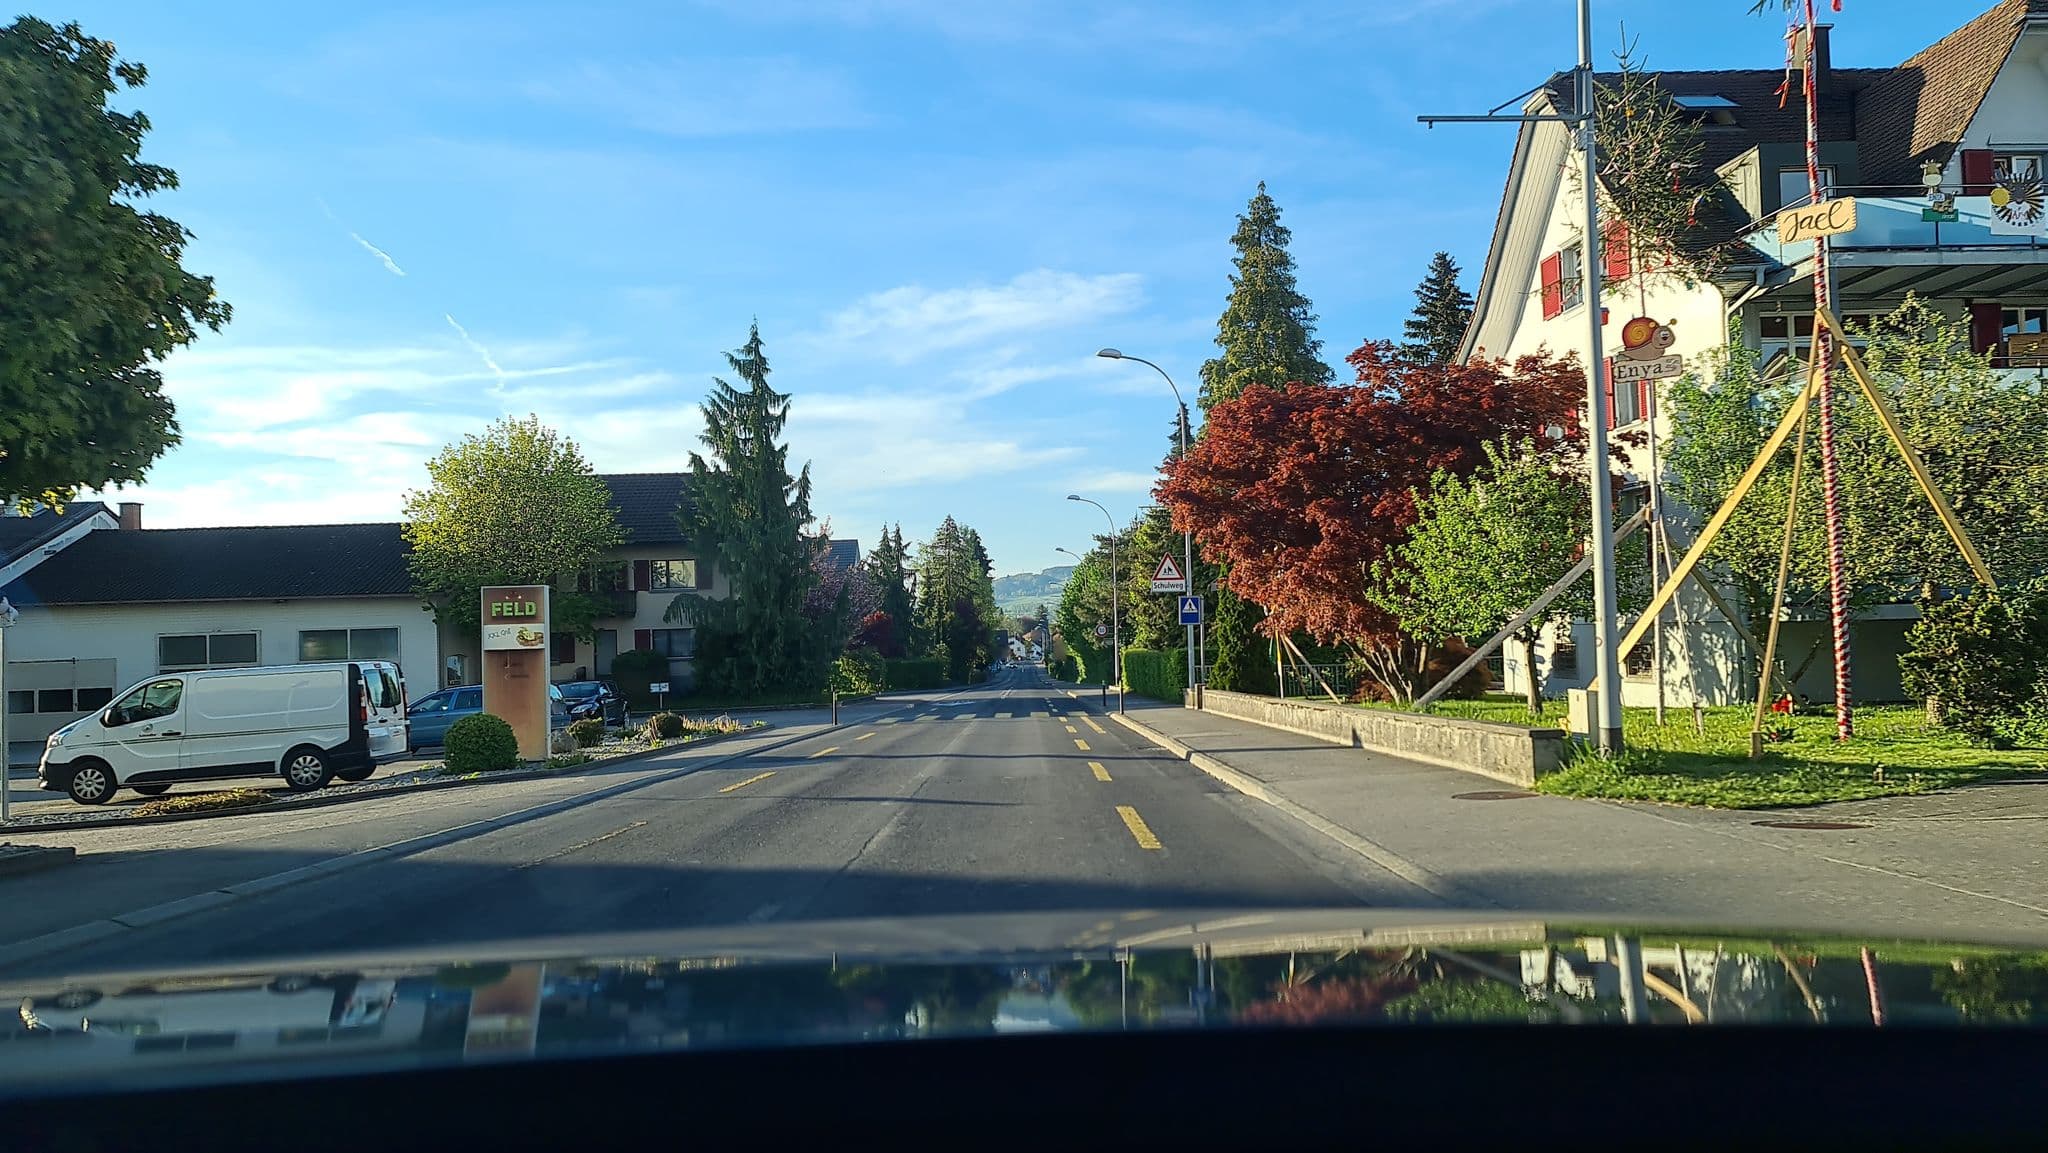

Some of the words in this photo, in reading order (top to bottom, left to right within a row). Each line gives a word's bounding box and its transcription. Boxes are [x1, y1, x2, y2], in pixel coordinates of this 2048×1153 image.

[1783, 201, 1849, 242] Jael
[1617, 363, 1663, 379] Enya
[1154, 582, 1184, 591] Schulweg
[491, 601, 536, 617] FELD
